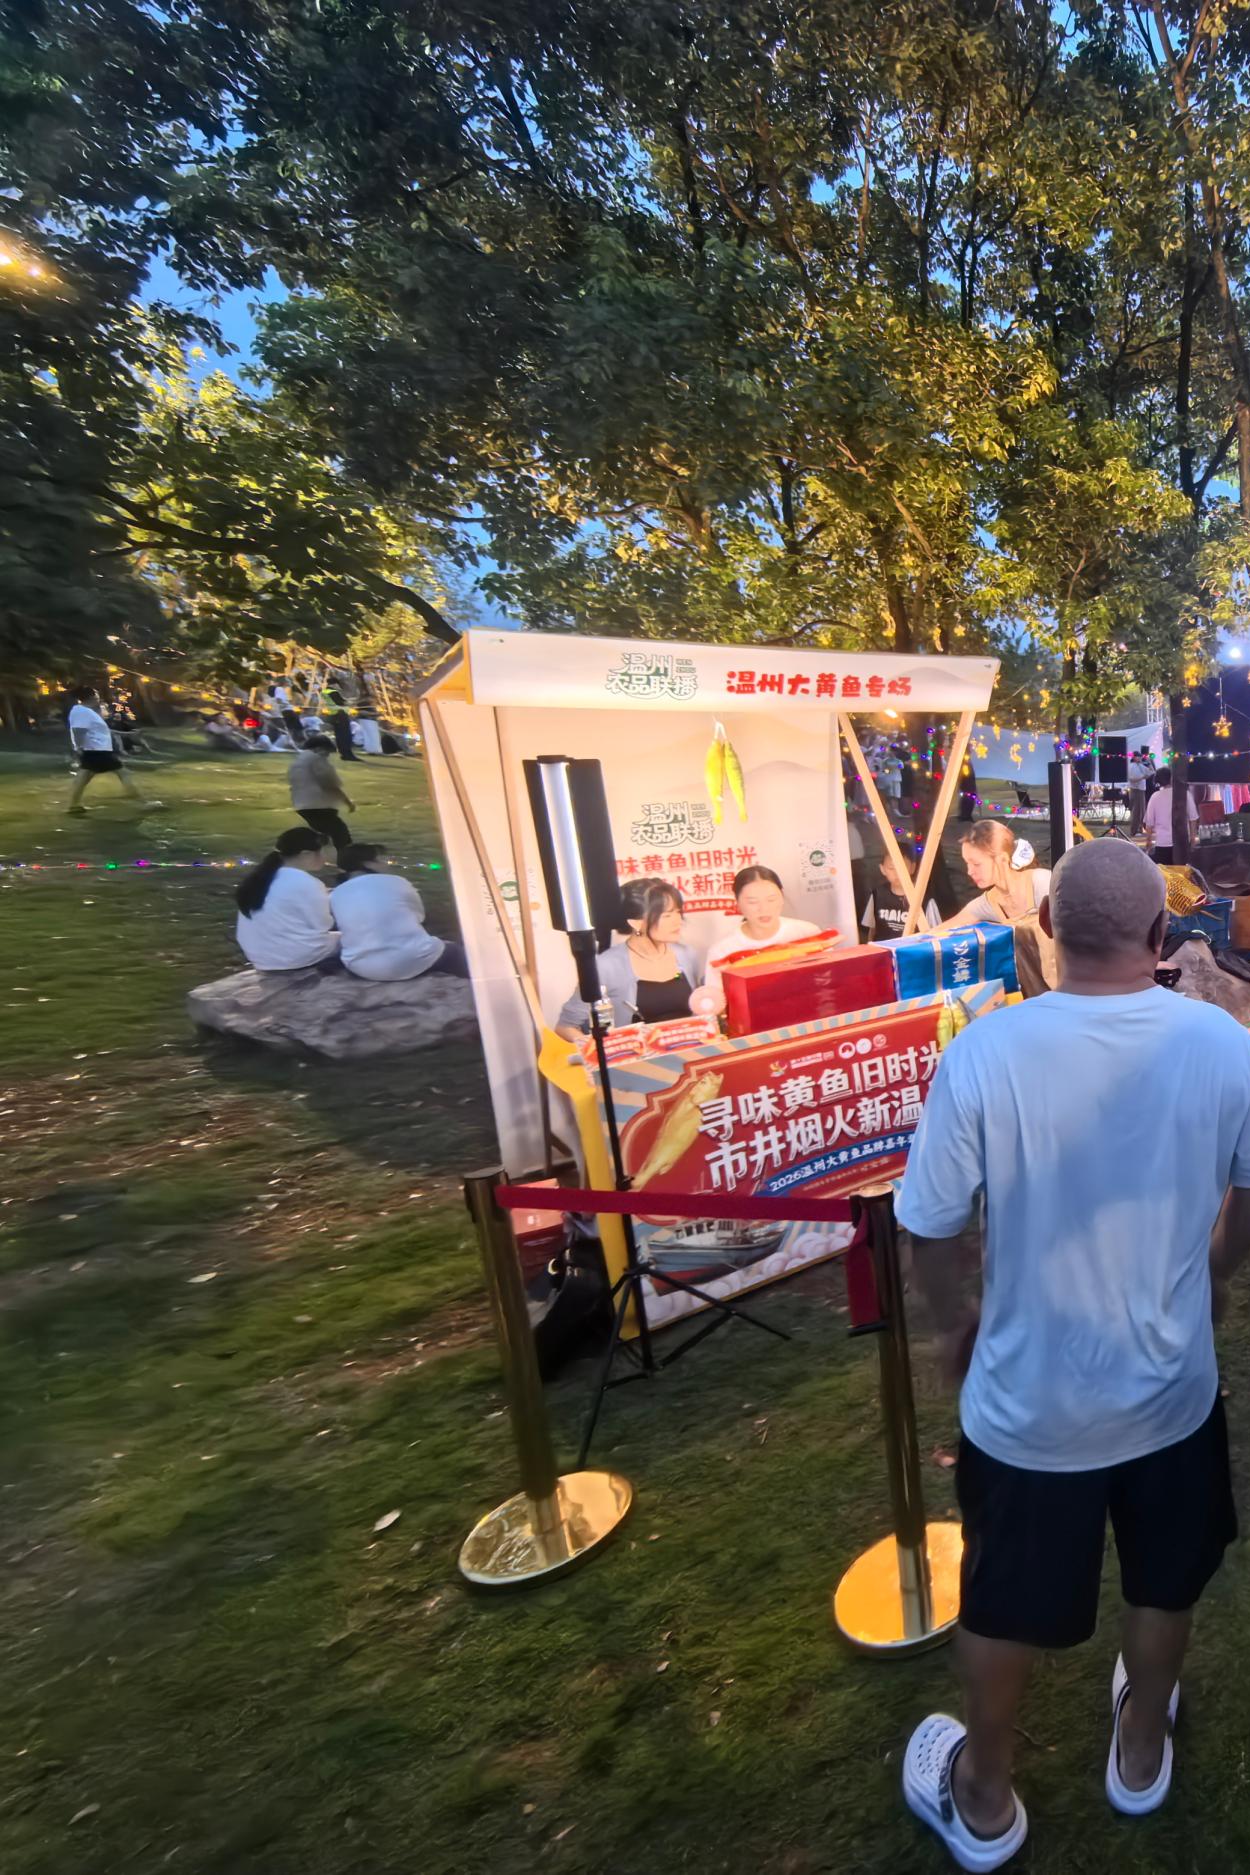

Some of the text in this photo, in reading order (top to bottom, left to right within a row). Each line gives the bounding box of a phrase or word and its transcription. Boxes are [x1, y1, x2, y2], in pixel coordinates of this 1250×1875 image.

[608, 652, 673, 677] 温州
[605, 674, 698, 700] 农品联播
[726, 670, 912, 698] 温州大黄鱼专场
[633, 801, 690, 826] 温州
[631, 822, 716, 848] 农品联播
[662, 870, 737, 897] 火新温
